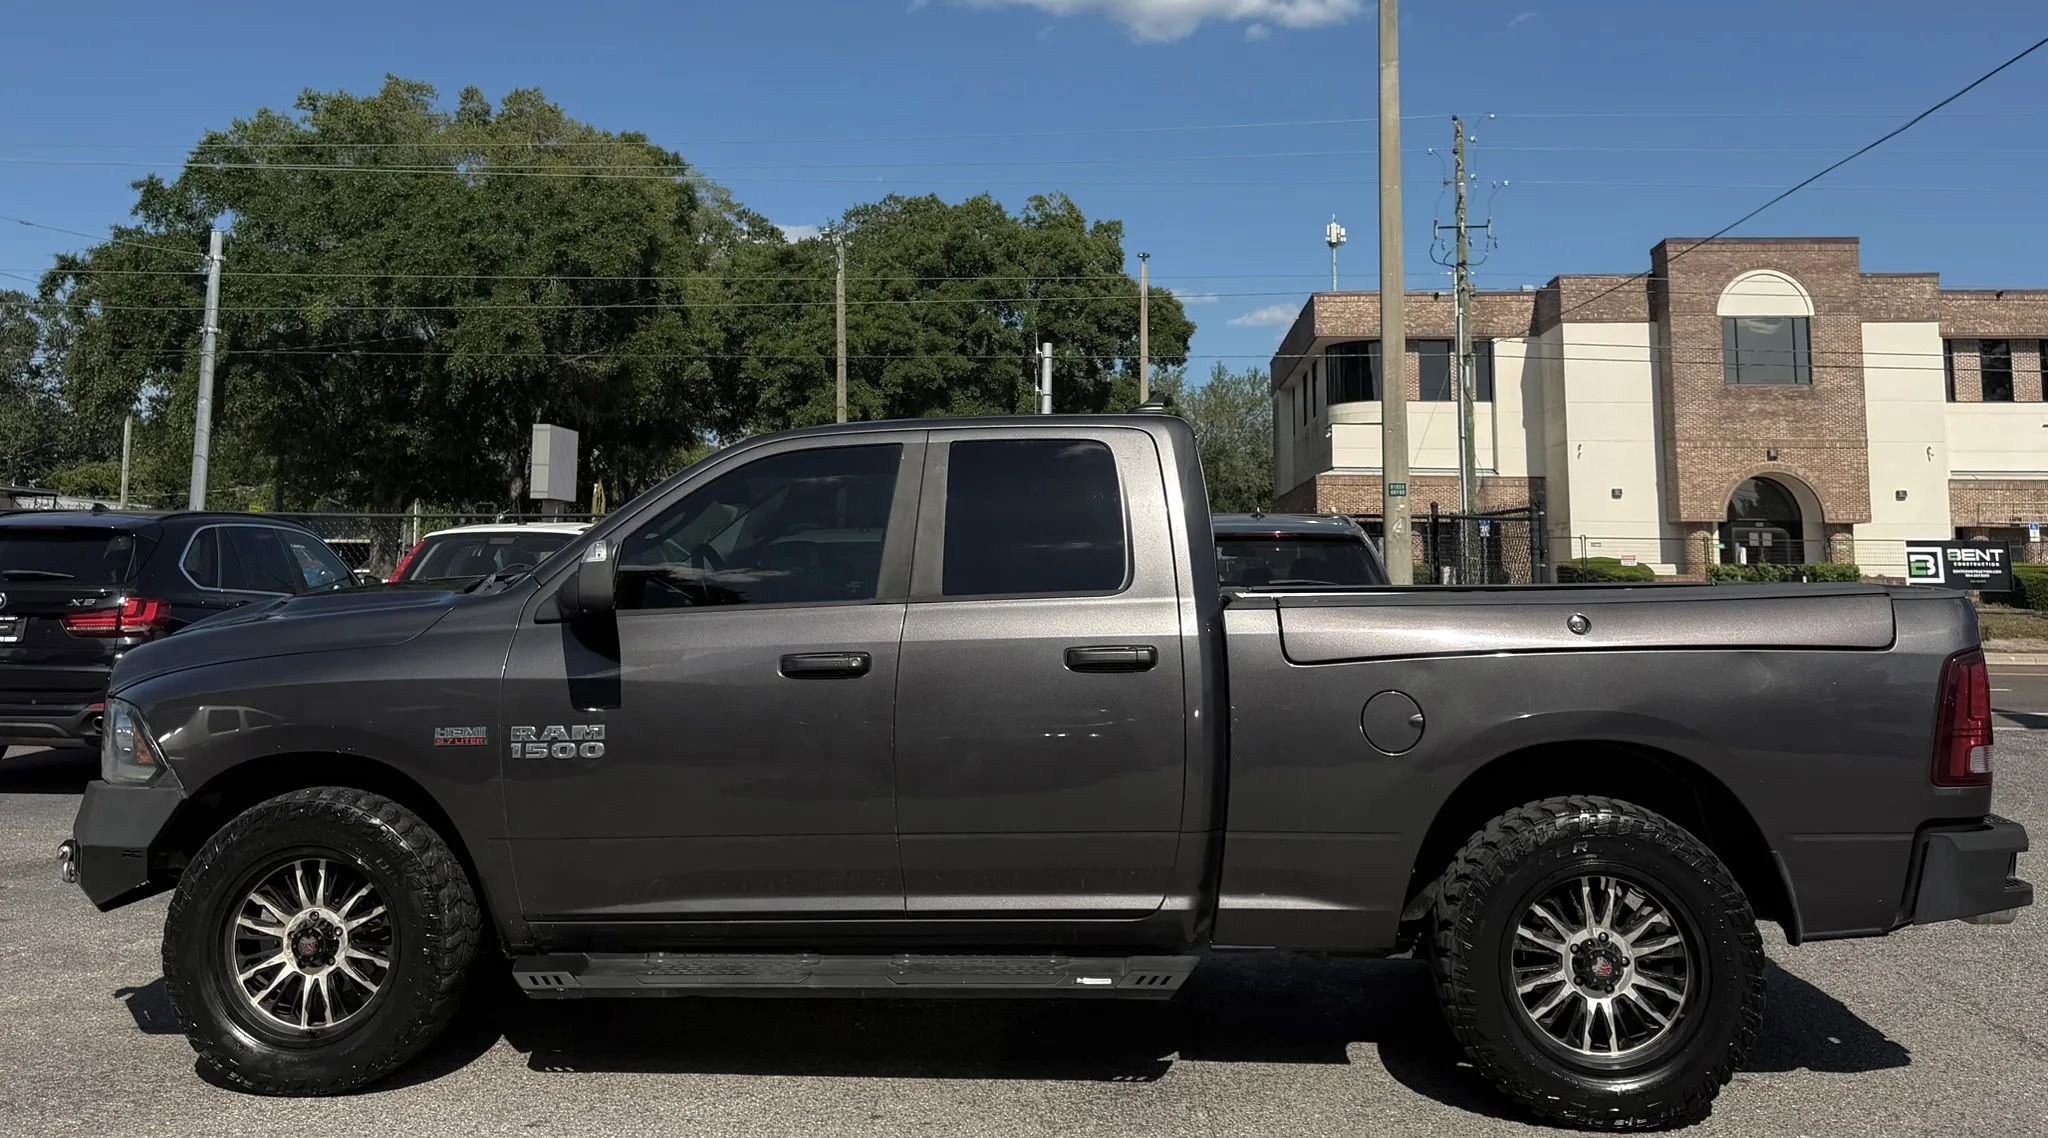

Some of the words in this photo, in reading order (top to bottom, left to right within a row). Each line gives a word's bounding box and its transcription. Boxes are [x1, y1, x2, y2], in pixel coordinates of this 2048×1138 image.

[1947, 549, 2004, 562] BENT
[435, 726, 486, 738] HEMI
[510, 724, 606, 741] RAM
[511, 742, 606, 759] 1500
